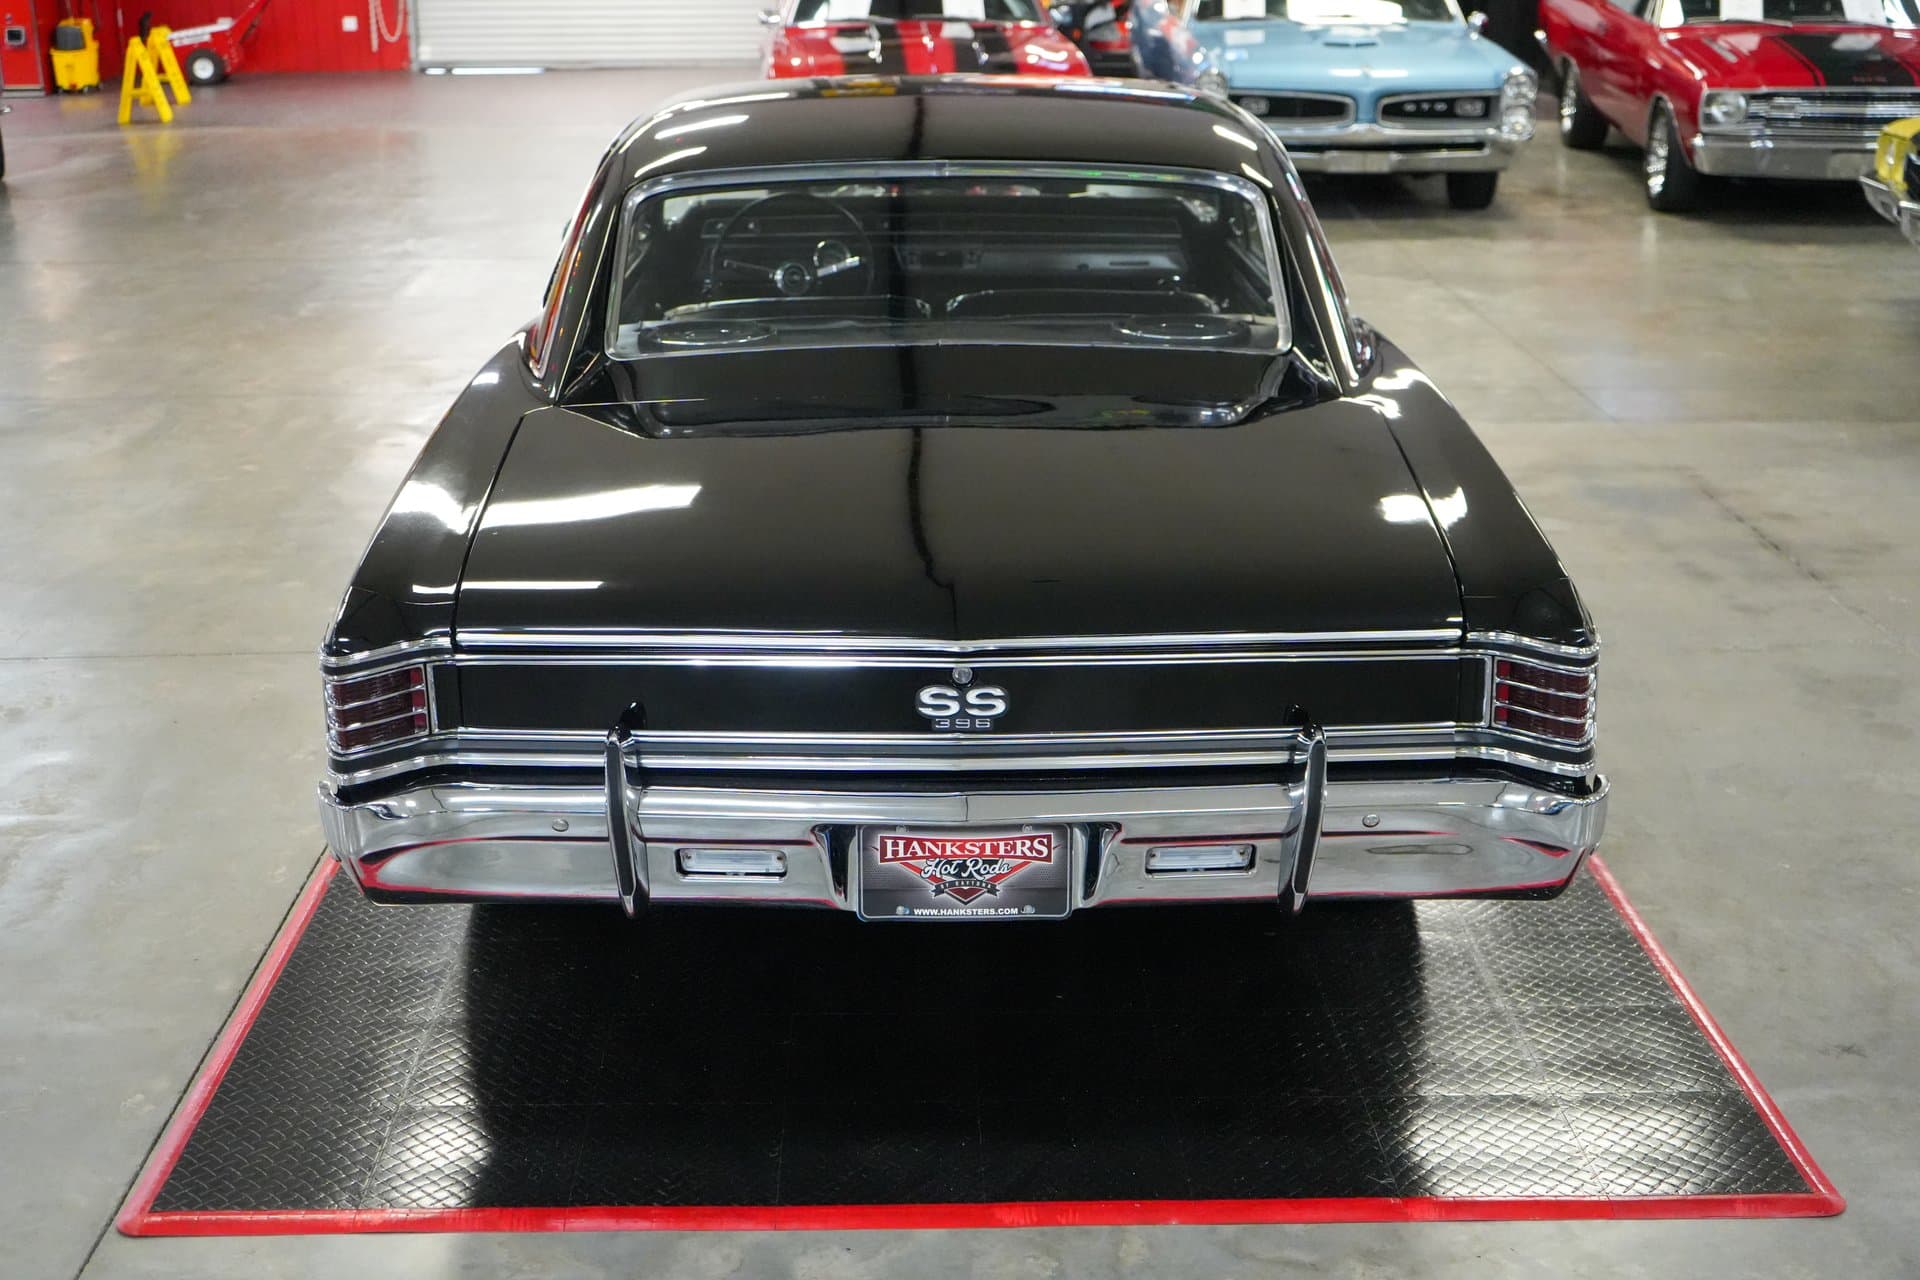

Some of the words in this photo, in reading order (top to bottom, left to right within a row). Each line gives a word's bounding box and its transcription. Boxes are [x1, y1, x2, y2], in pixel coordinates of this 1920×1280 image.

[918, 686, 1006, 716] SS
[935, 718, 991, 729] 396
[884, 838, 1048, 859] HANKSTERS
[921, 858, 963, 878] Hot
[961, 857, 1011, 881] Rods
[913, 907, 1018, 916] WWW.HANKSTERS.COM
